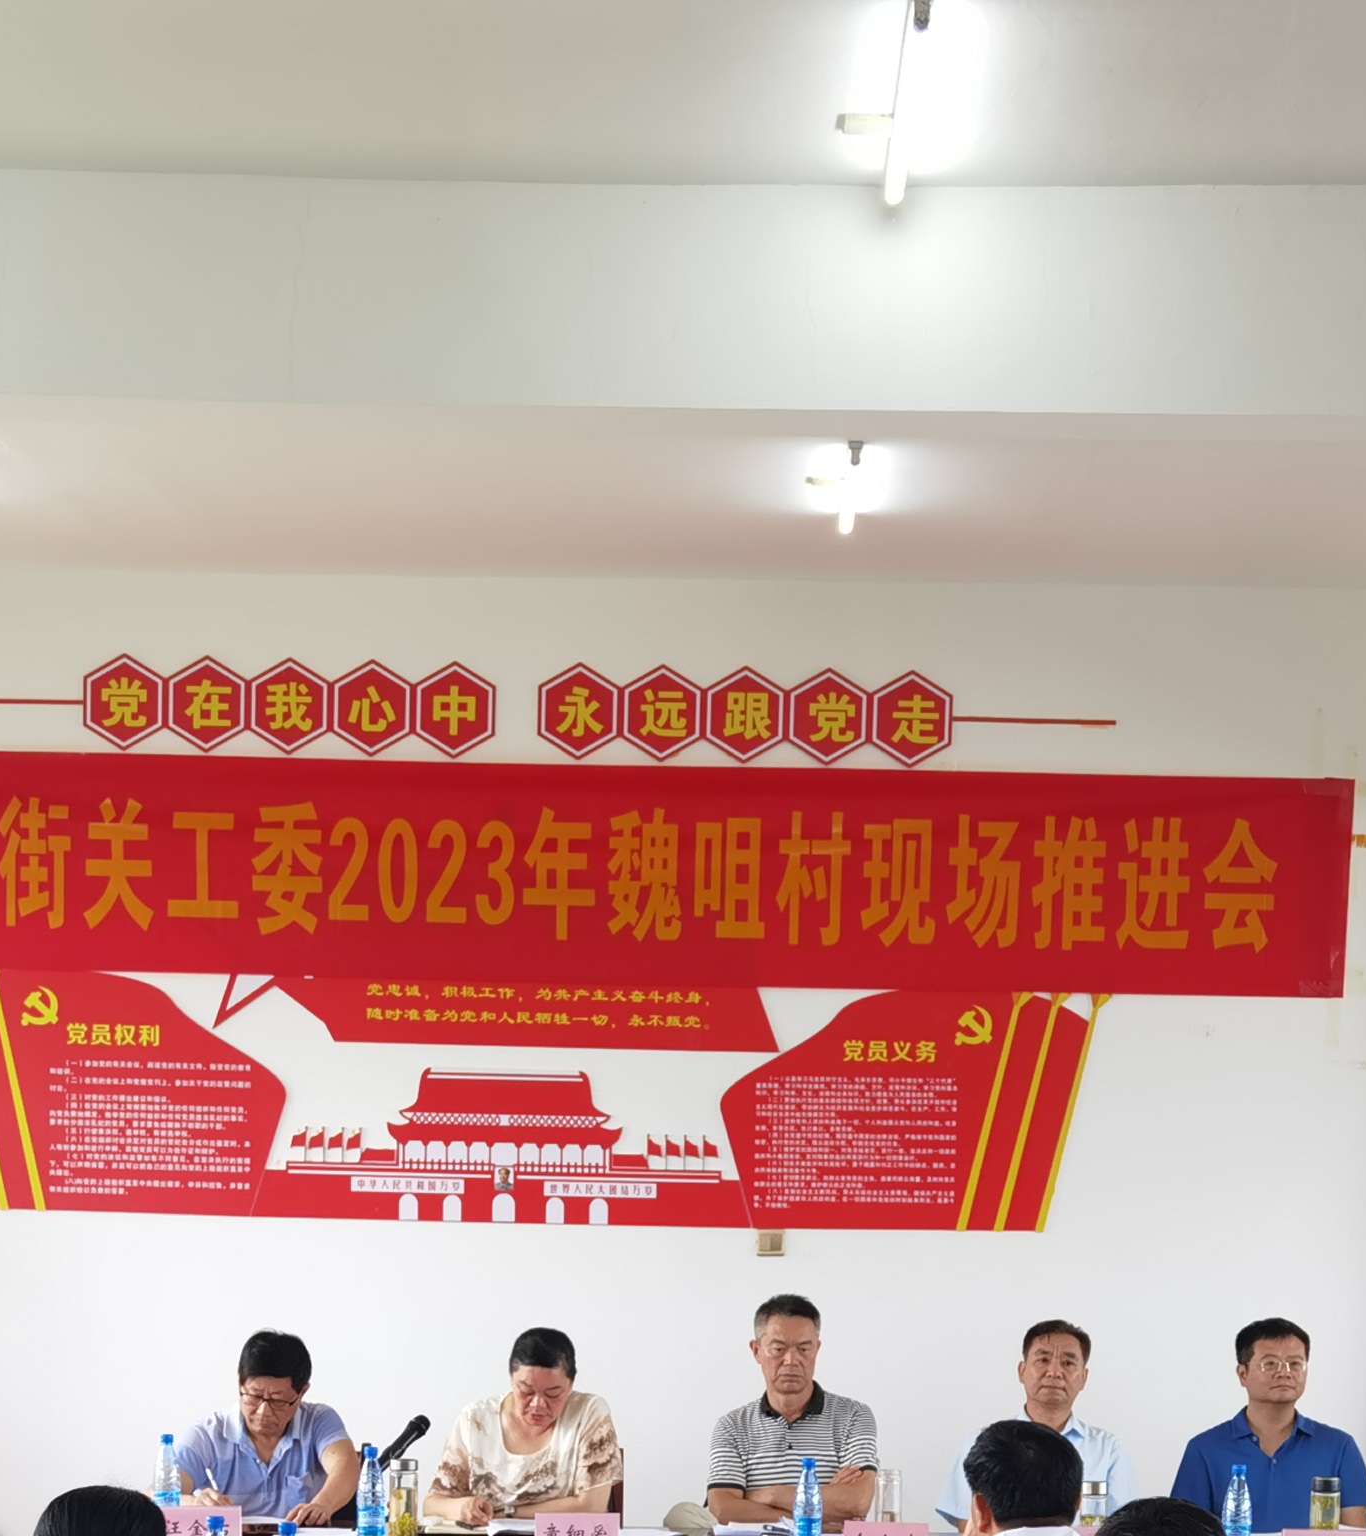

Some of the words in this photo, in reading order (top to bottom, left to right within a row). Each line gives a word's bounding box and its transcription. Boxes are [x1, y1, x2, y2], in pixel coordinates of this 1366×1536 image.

[100, 678, 478, 737] 党在我心中
[557, 685, 942, 747] 永远跟党走
[65, 1022, 161, 1047] 党员权利
[843, 1040, 937, 1063] 党员义务
